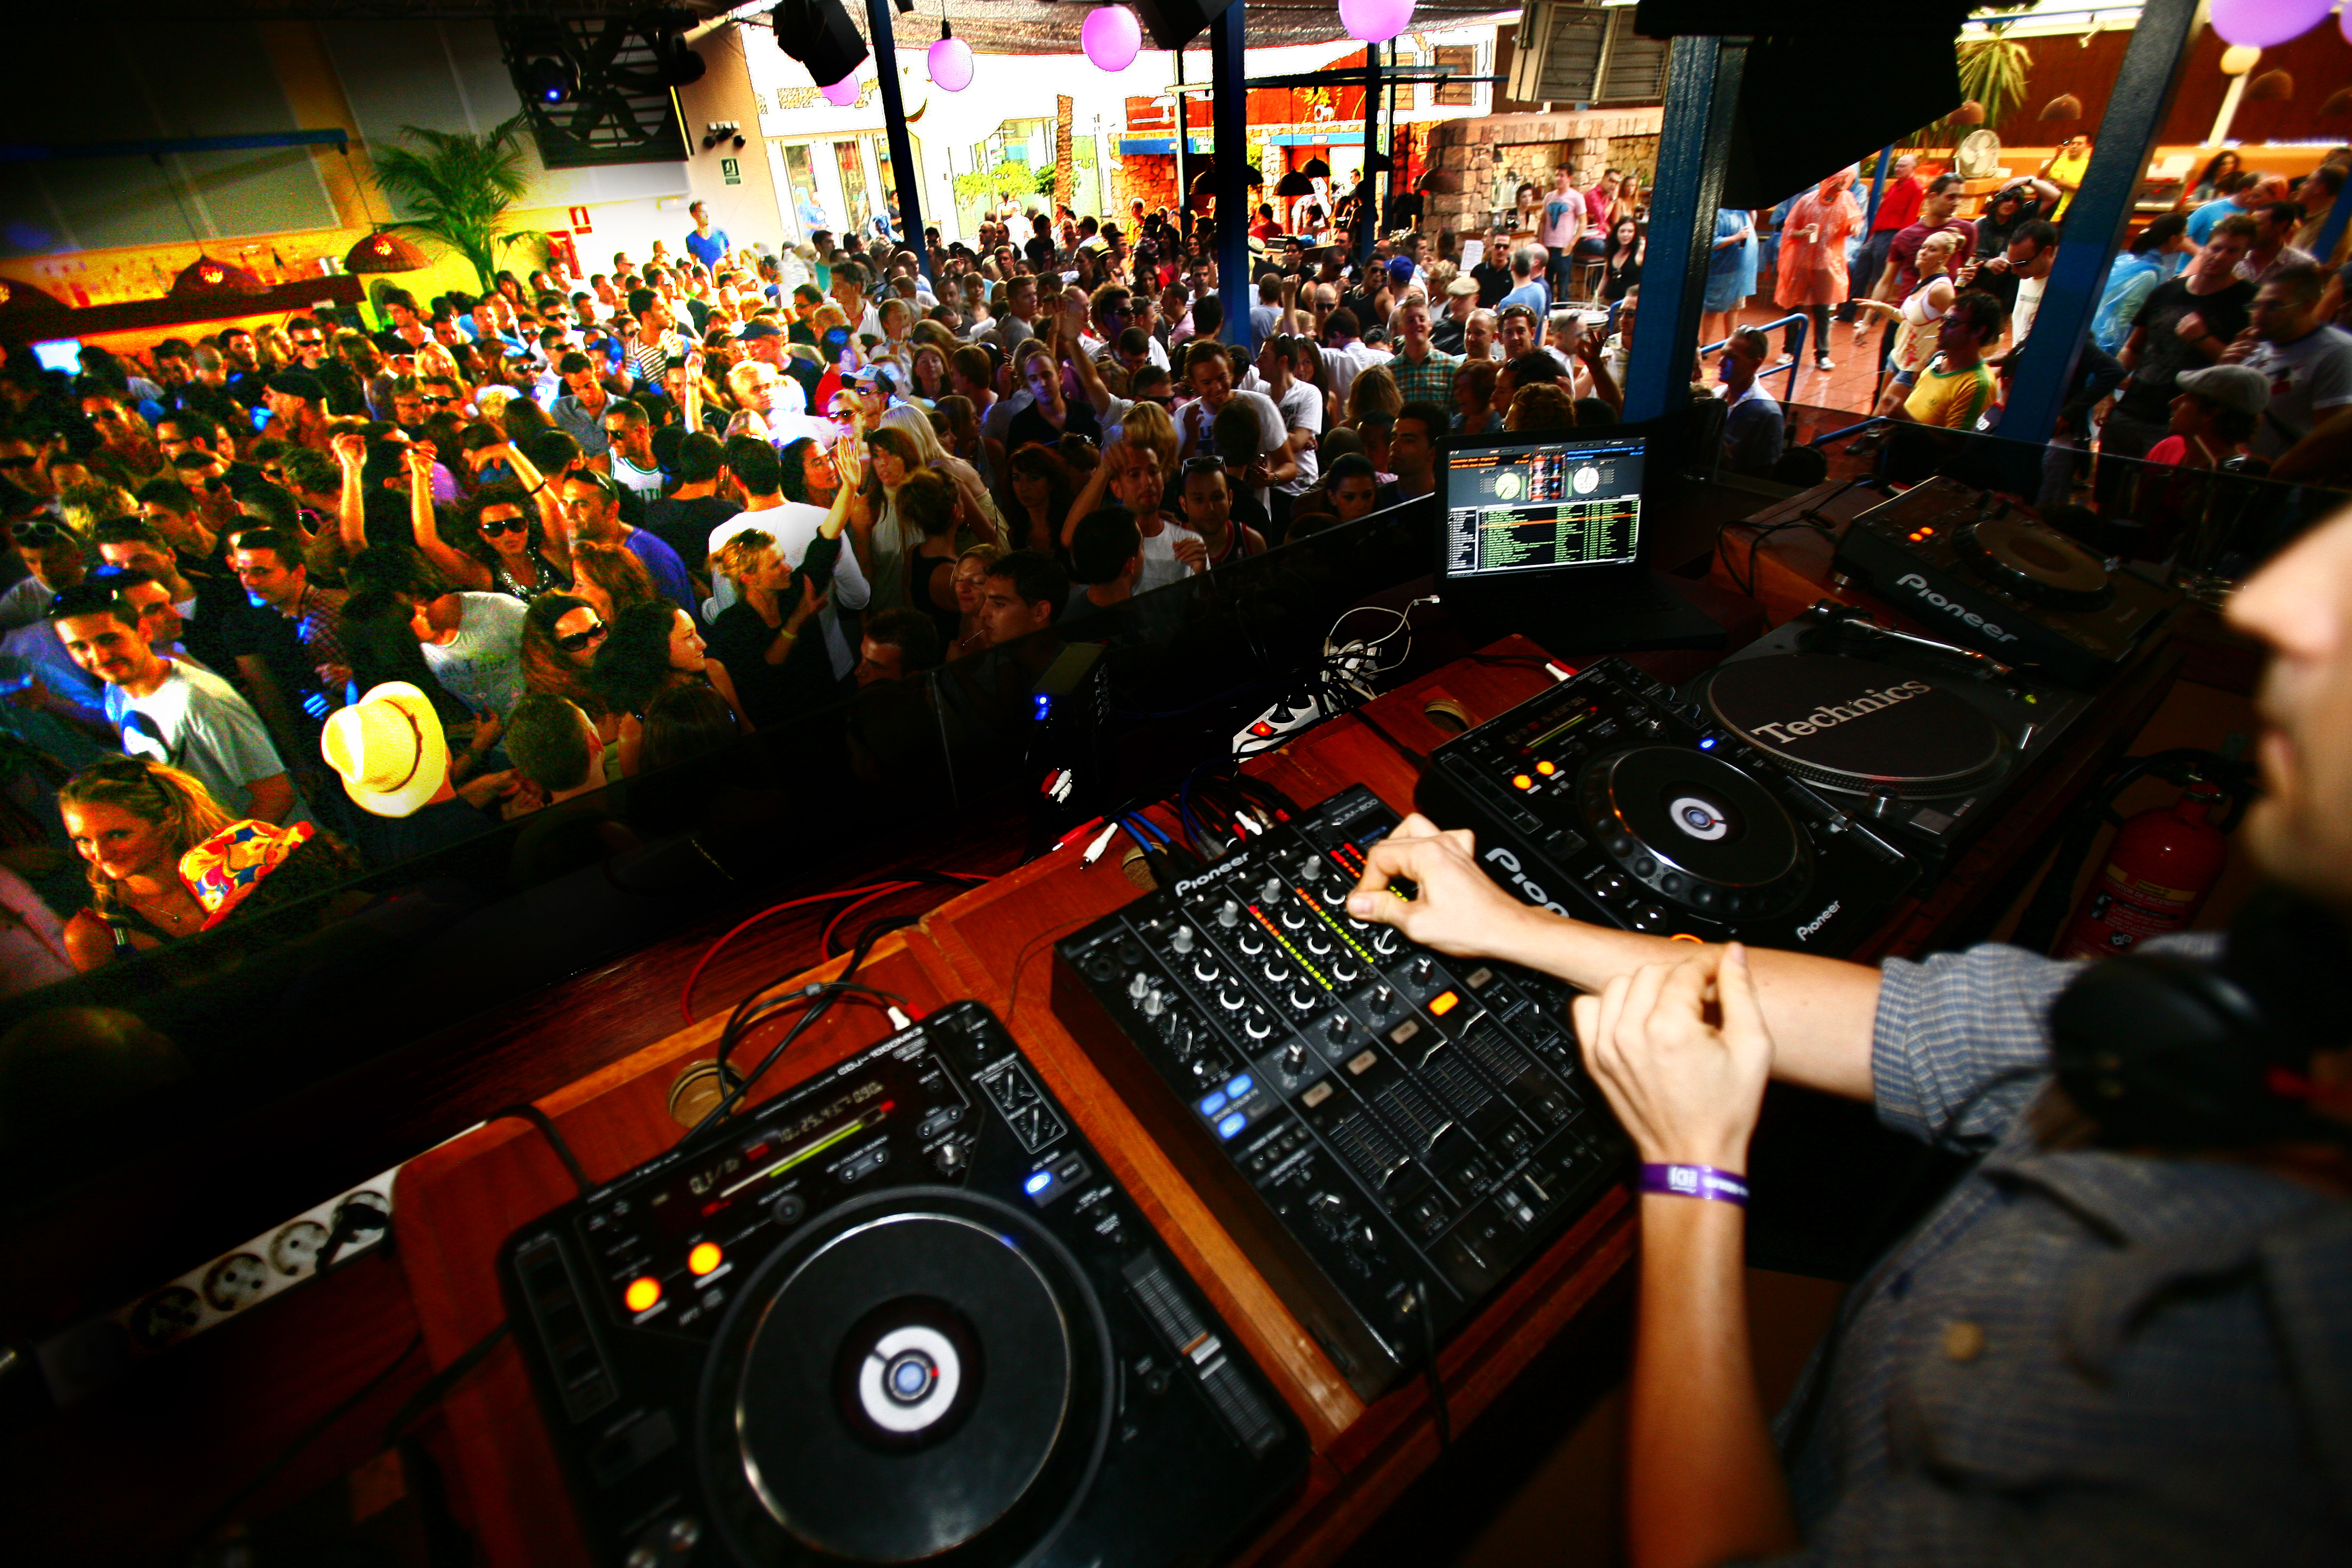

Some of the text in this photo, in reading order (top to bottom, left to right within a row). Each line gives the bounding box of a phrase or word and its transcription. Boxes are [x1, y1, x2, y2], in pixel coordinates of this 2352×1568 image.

[1896, 573, 2019, 643] Pioneer
[1751, 680, 1932, 744] Technics
[1175, 851, 1250, 896] Pioneer
[1486, 847, 1570, 919] Pion
[2134, 891, 2145, 899] DE
[1797, 900, 1842, 941] Pioneer
[837, 1026, 924, 1075] CDJ-1000MK3
